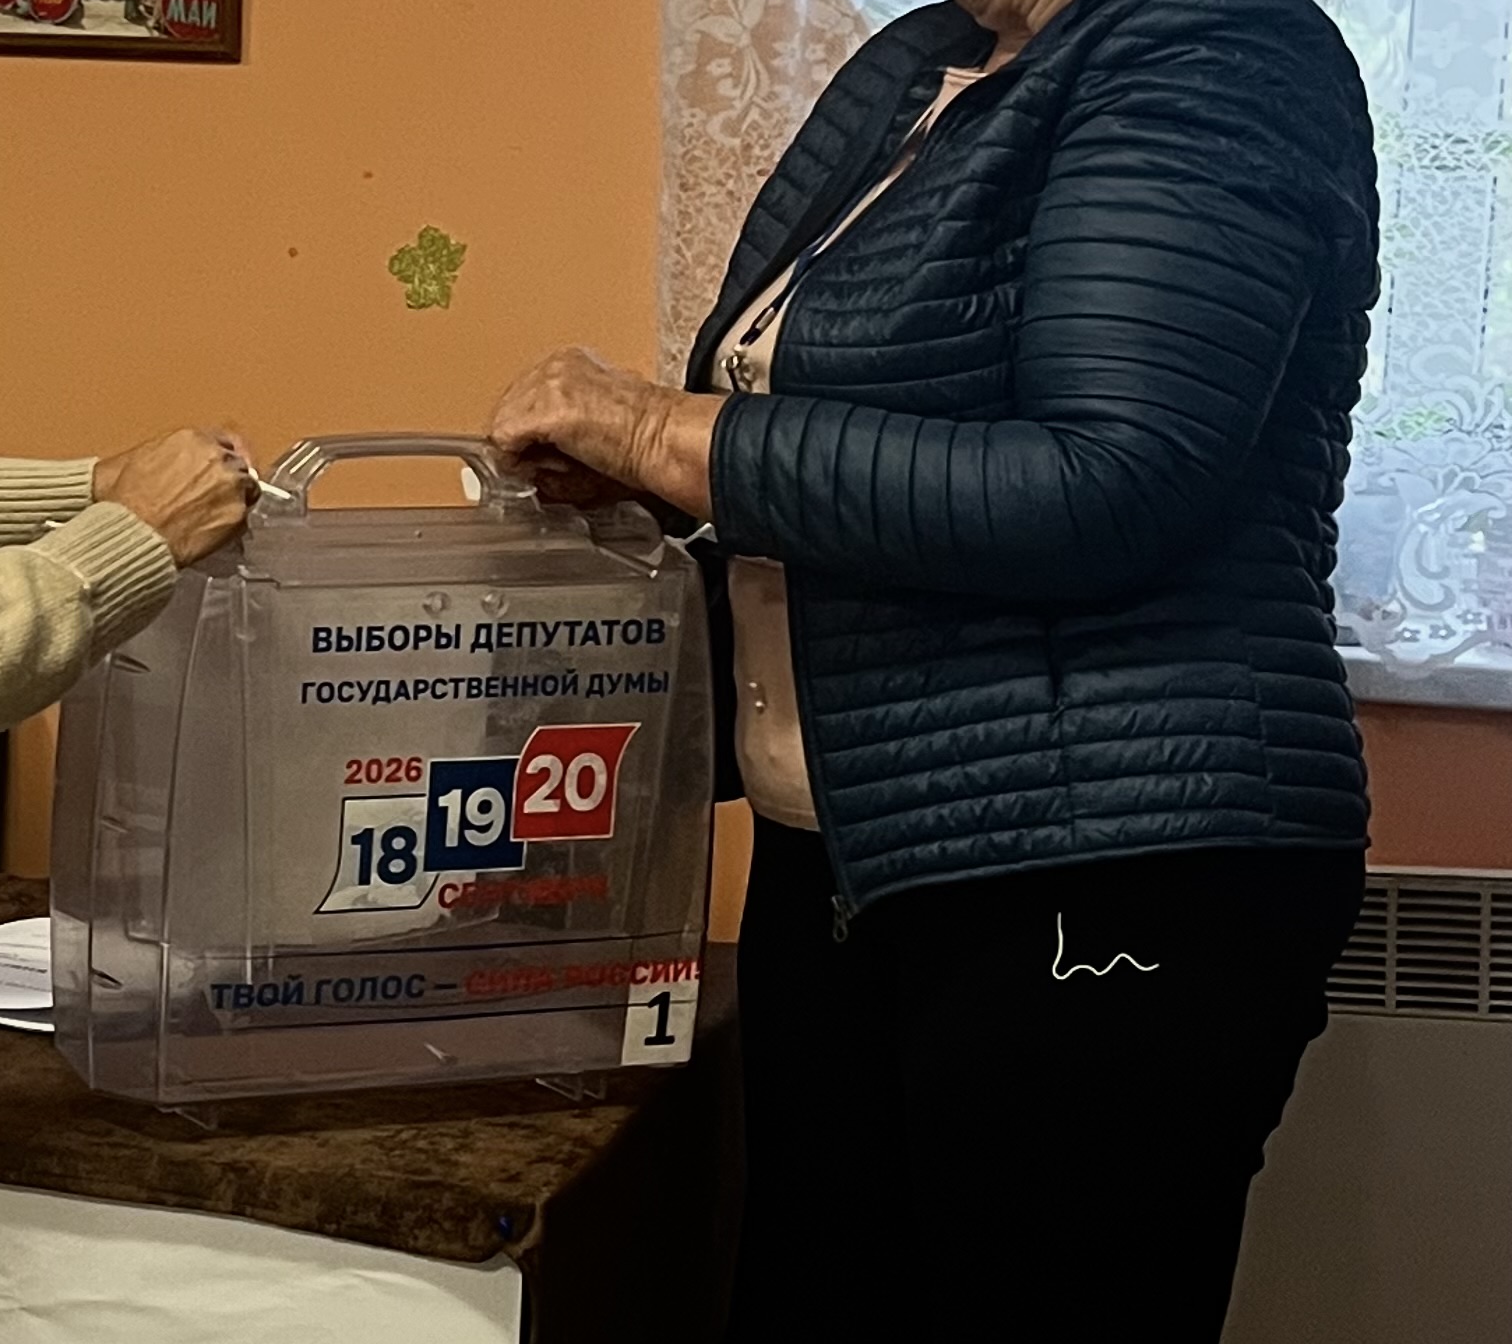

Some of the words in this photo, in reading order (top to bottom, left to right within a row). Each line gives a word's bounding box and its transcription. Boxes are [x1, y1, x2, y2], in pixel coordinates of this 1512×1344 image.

[312, 624, 461, 653] ВЫБОРЫ
[470, 618, 666, 653] ДЕПУТАТОВ
[301, 668, 579, 705] ГОСУДАРСТВЕННОЙ
[585, 671, 669, 699] ДУМЫ
[344, 757, 423, 784] 2026
[350, 825, 418, 886] 18
[438, 787, 505, 847] 19
[523, 752, 607, 814] 20
[210, 974, 304, 1009] ТВОЙ
[314, 973, 426, 1005] ГОЛОС
[644, 991, 676, 1047] 1
